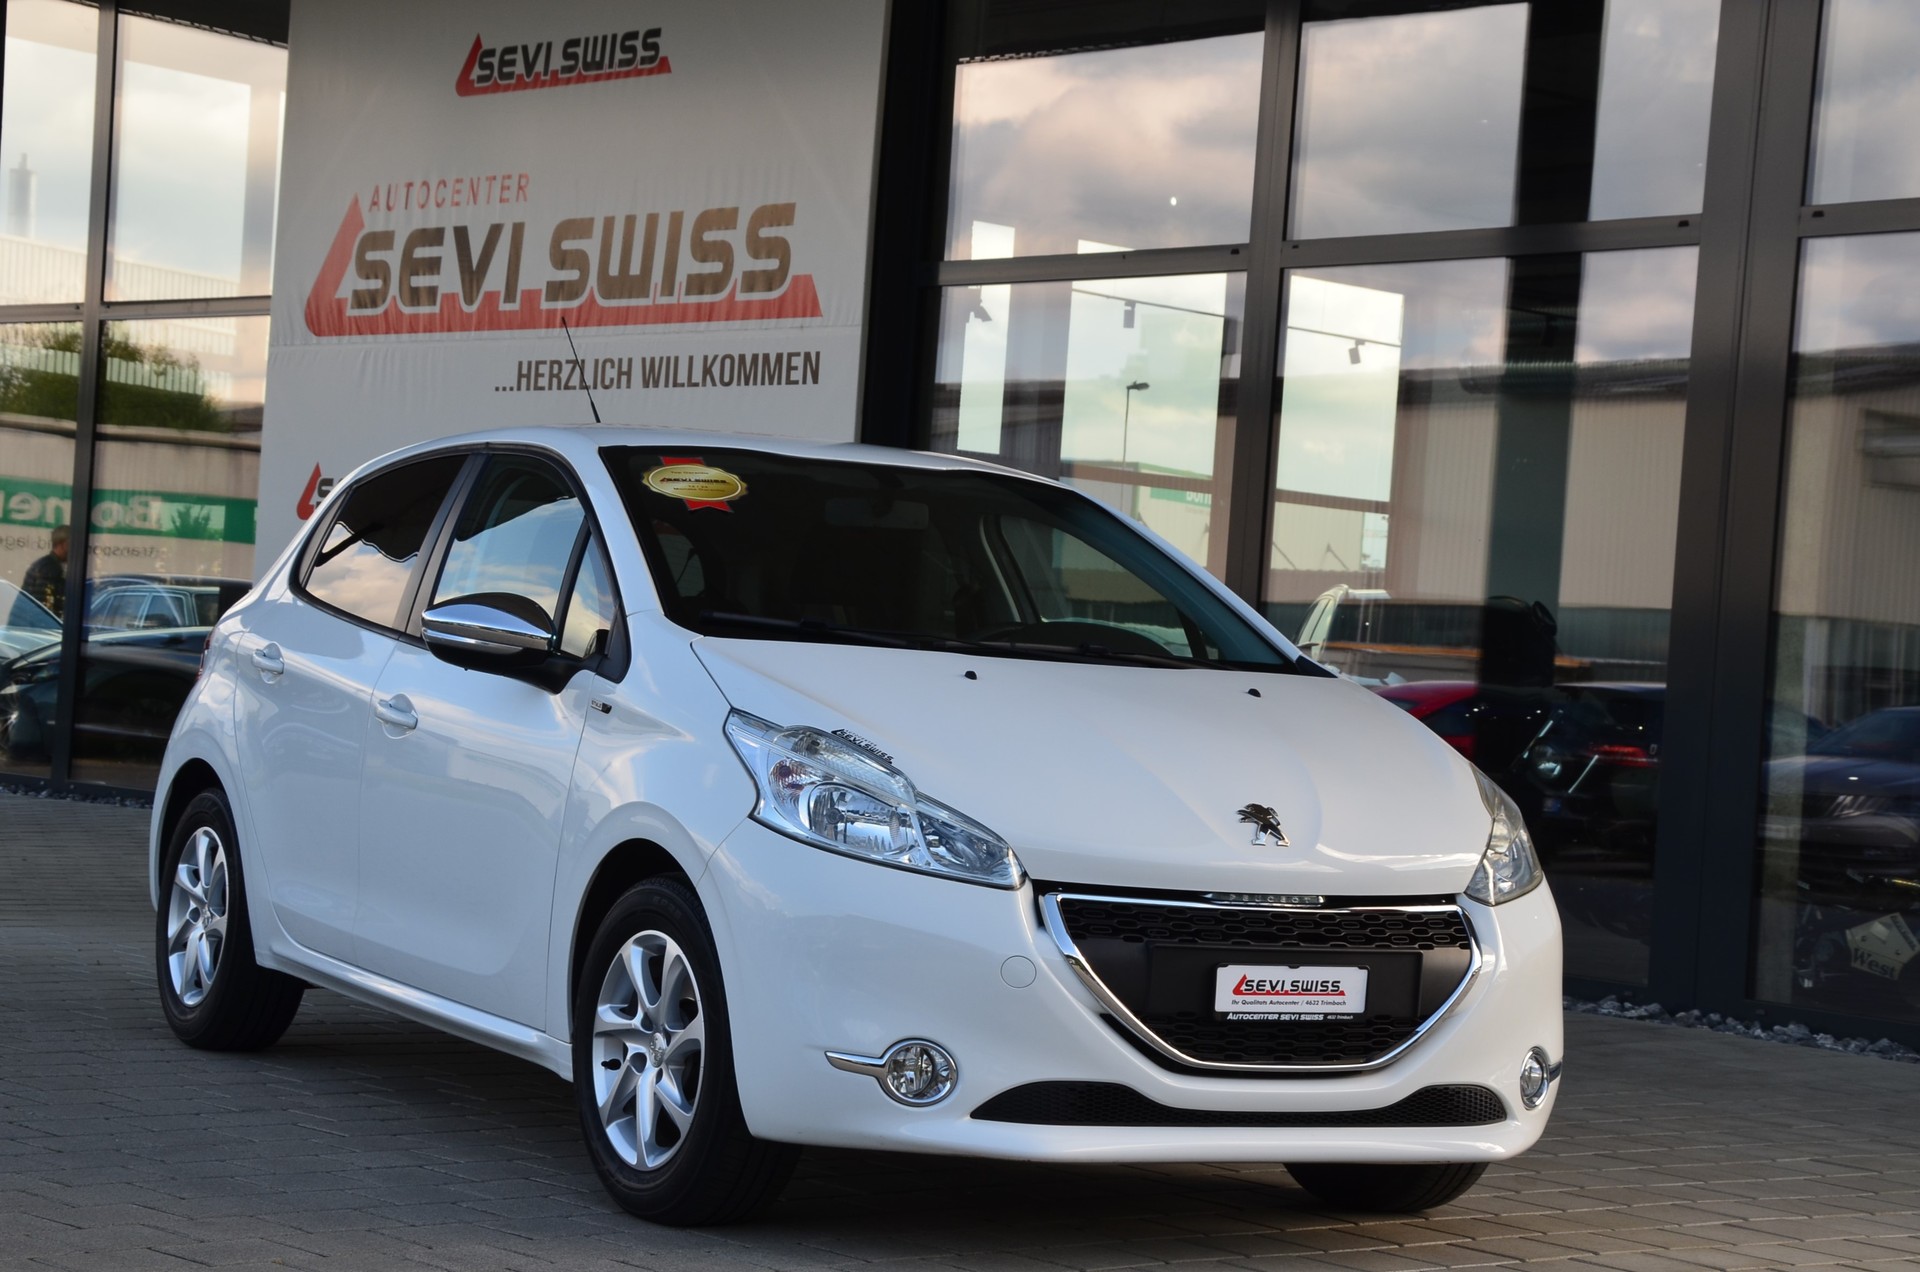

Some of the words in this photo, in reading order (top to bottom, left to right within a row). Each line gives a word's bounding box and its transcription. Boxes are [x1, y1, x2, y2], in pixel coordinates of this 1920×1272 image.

[476, 41, 553, 85] SEVI
[559, 27, 662, 76] SWISS
[368, 173, 530, 213] AUTOCENTER
[350, 221, 526, 310] SEVI
[544, 202, 797, 303] SWISS
[640, 351, 821, 389] WILLKOMMEN
[838, 730, 864, 746] SEVI
[863, 743, 895, 762] SWISS
[1244, 979, 1285, 992] SEVI
[1289, 980, 1341, 993] SWISS
